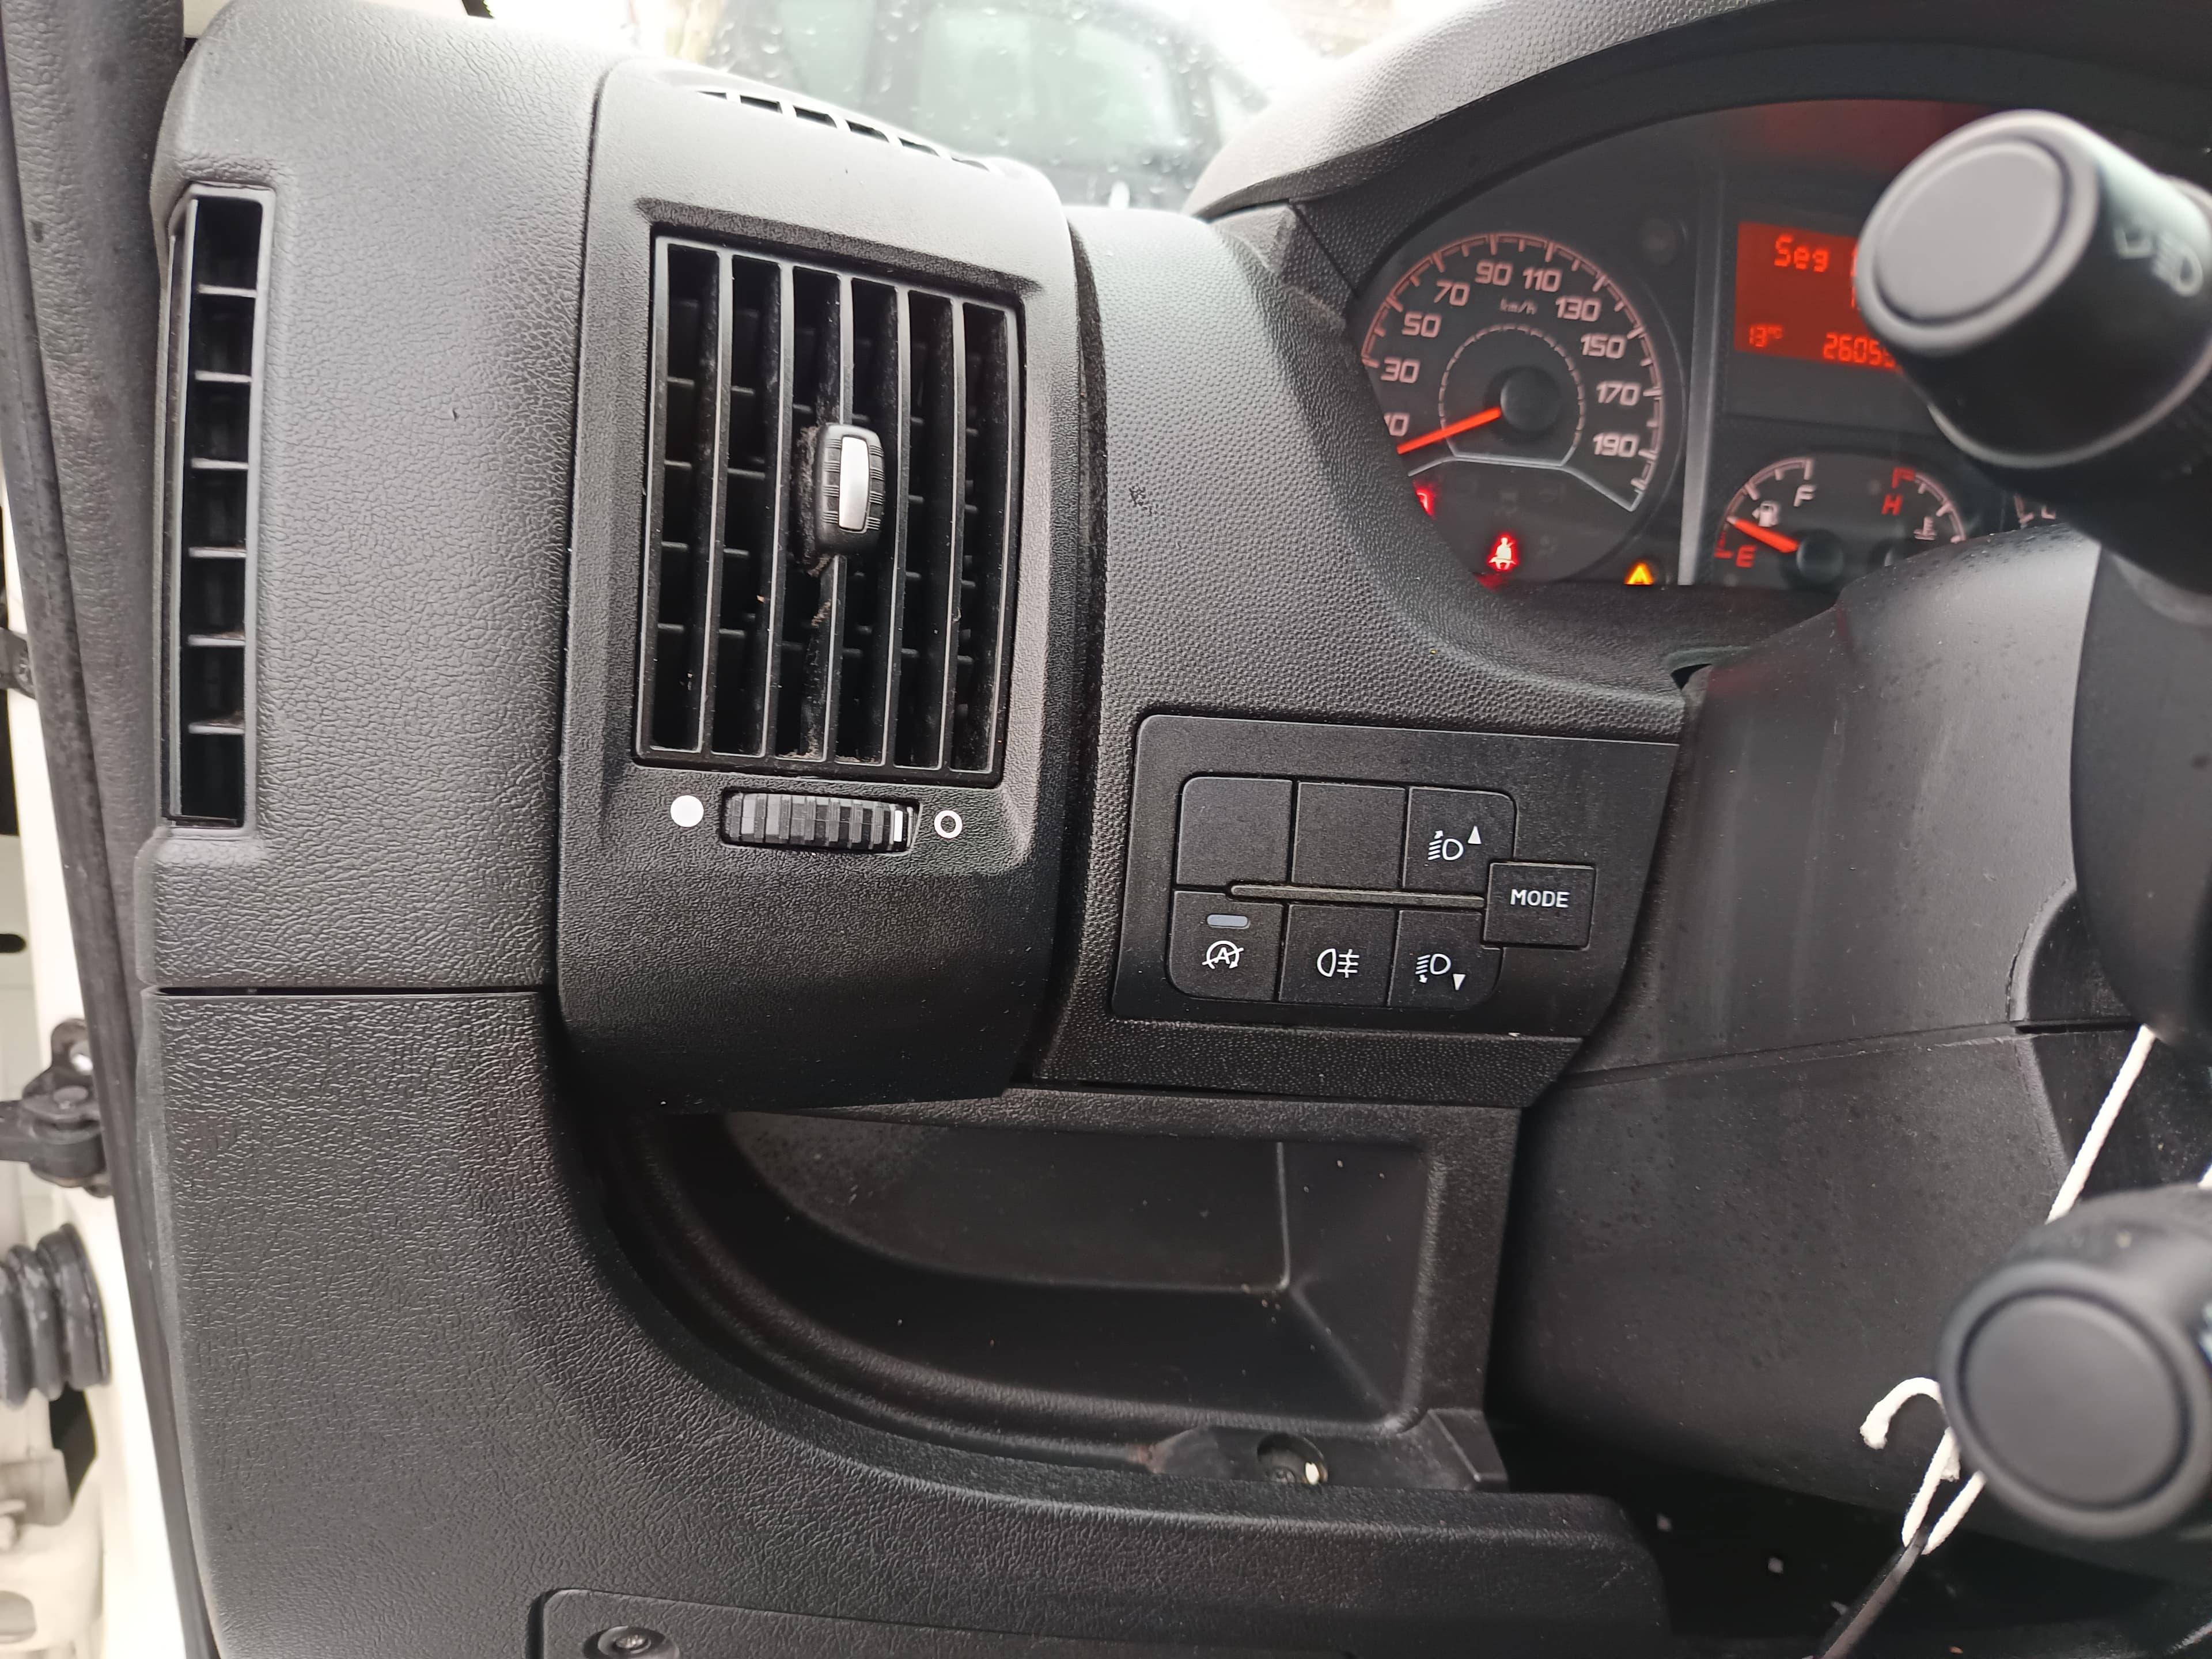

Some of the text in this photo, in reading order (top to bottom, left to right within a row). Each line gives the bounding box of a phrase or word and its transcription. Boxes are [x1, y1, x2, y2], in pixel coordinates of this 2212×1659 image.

[1774, 233, 1830, 273] Seg
[1475, 260, 1512, 286] 90
[1522, 267, 1562, 293] 110
[1434, 281, 1471, 306] 70
[1500, 296, 1537, 315] km/h
[1556, 296, 1601, 321] 130
[1402, 312, 1441, 338] 50
[1580, 334, 1626, 359] 150
[1380, 357, 1421, 383] 30
[1596, 381, 1642, 406] 170
[1593, 433, 1641, 457] 190
[1793, 484, 1817, 507] F
[1881, 493, 1903, 516] H
[1736, 544, 1758, 568] E
[1510, 888, 1571, 908] MODE
